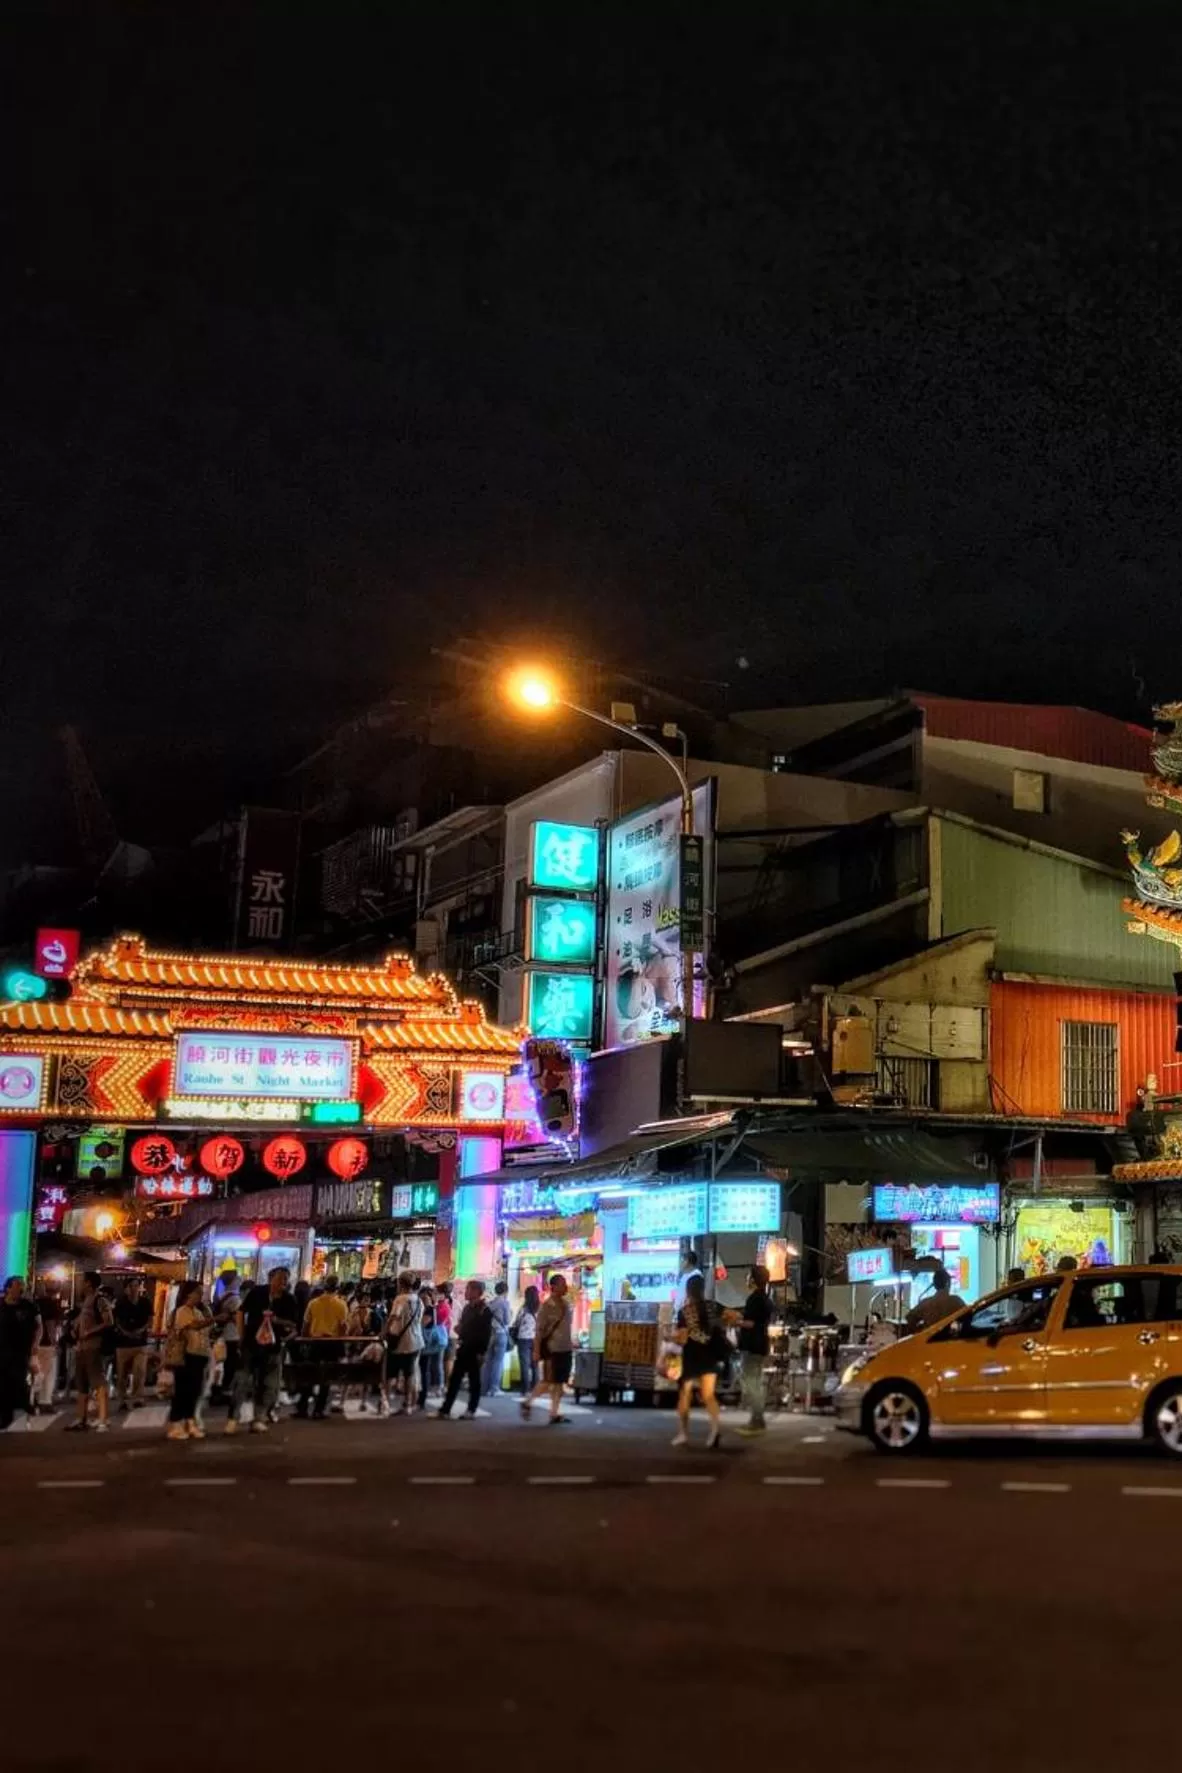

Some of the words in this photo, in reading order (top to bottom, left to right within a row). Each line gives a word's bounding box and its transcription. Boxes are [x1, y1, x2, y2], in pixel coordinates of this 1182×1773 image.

[248, 869, 287, 940] 永和
[186, 1045, 344, 1068] 饒河街觀光夜市
[184, 1072, 224, 1087] Raohe
[256, 1073, 291, 1089] Night
[299, 1075, 345, 1088] Market
[273, 1148, 300, 1170] 新
